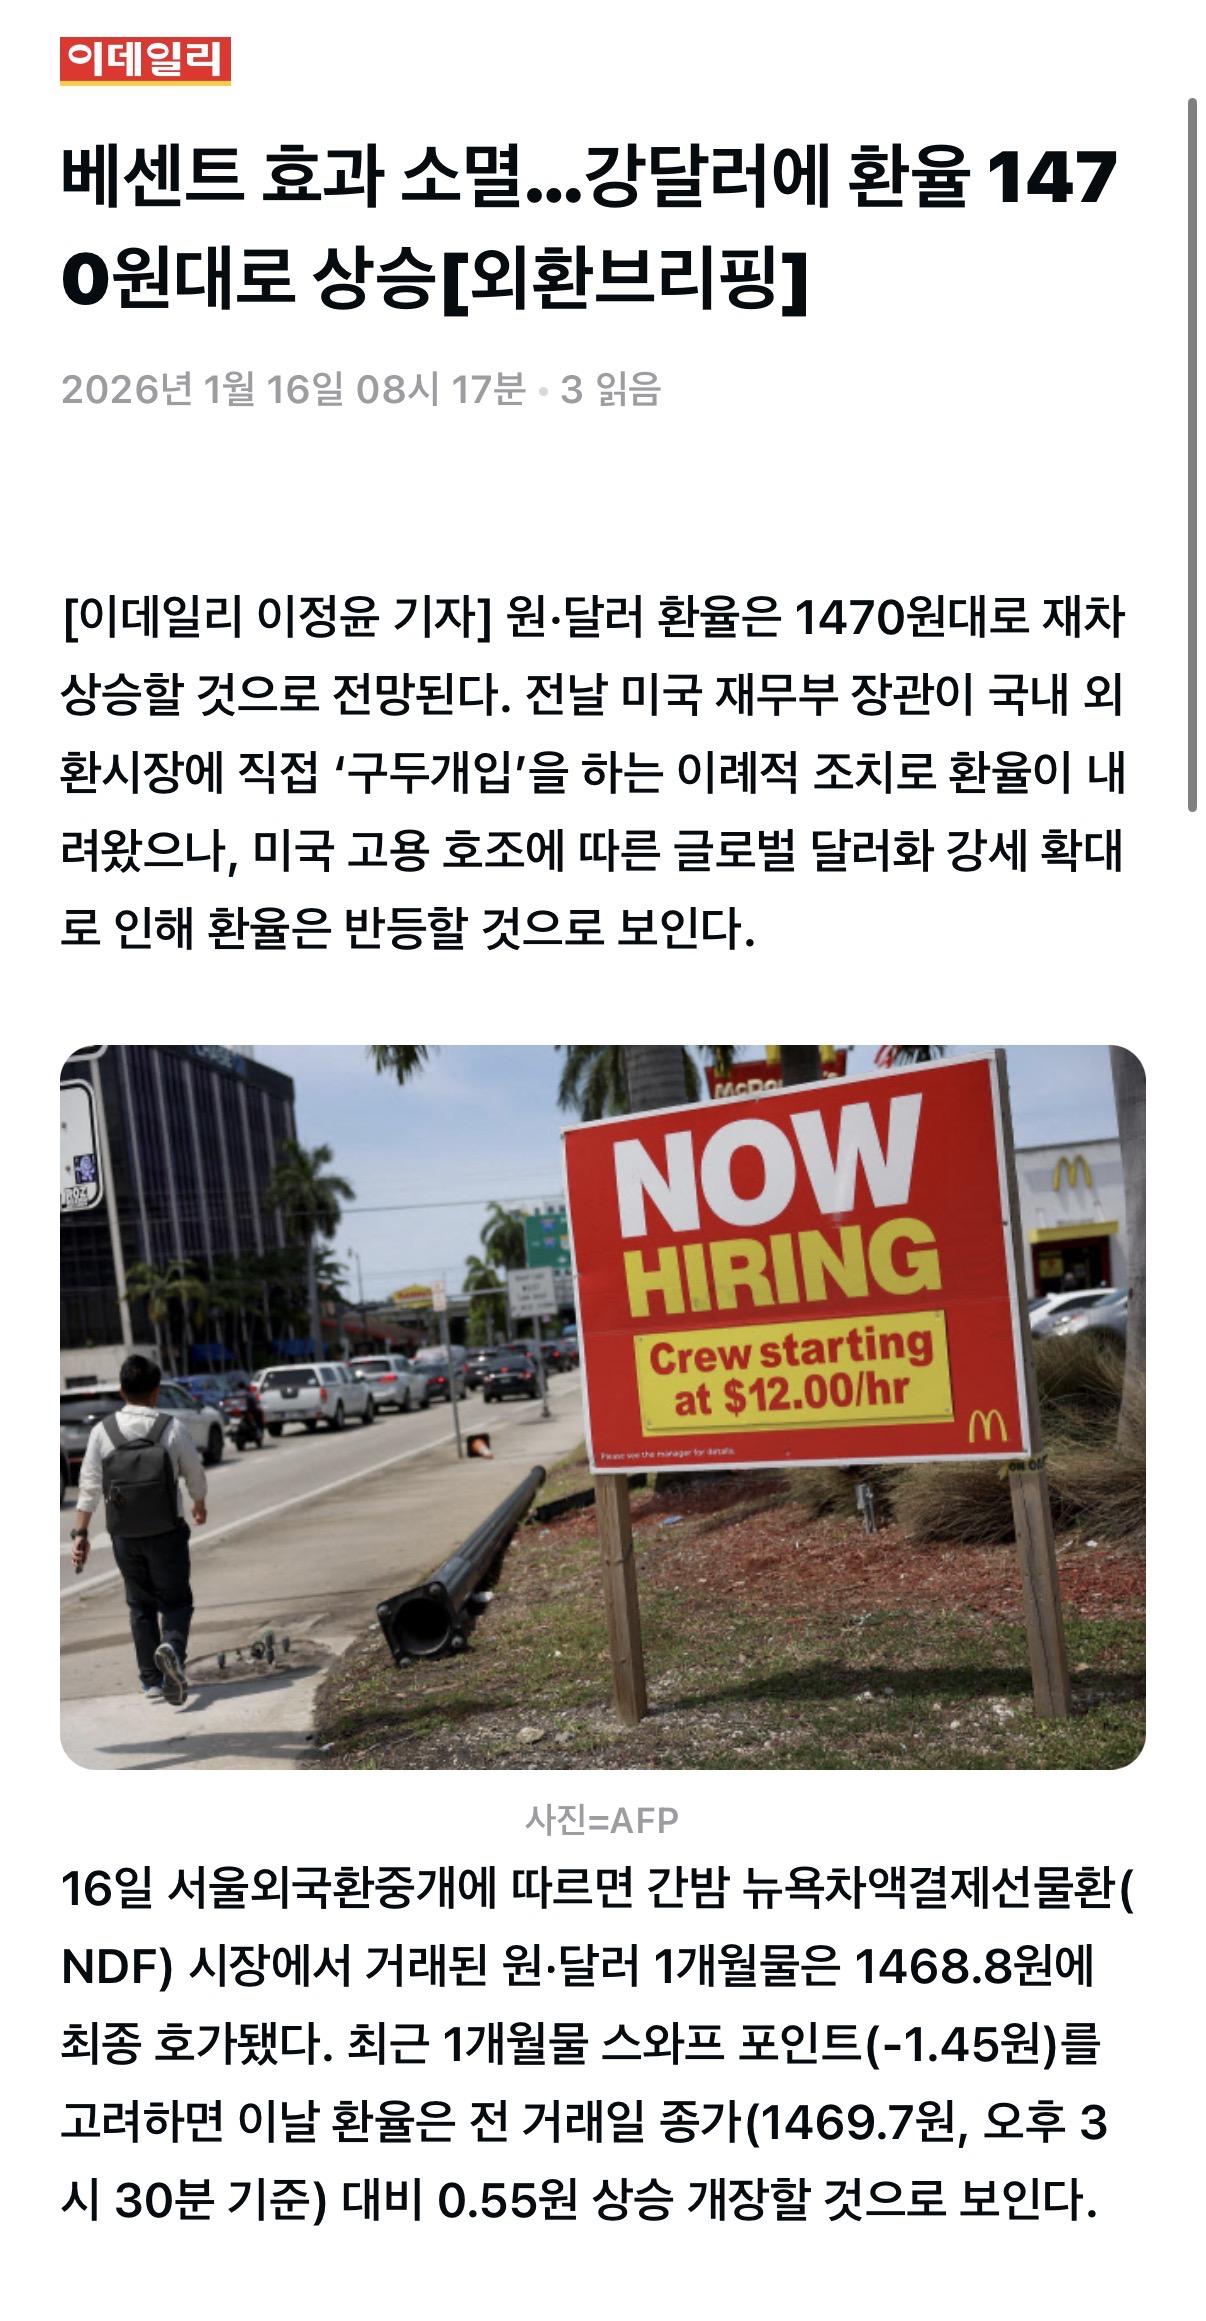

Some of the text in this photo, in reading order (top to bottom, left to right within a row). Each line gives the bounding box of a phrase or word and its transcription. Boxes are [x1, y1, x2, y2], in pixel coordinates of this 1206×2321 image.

[68, 41, 221, 77] 이데일리
[63, 143, 244, 208] 베센트
[263, 143, 385, 208] 효과
[849, 143, 971, 208] 환율
[990, 151, 1116, 202] 147
[63, 245, 806, 317] 0원대로 상승[외환브리핑]
[63, 371, 661, 406] 2026년 1월 16일 08시 17분 3 읽음
[66, 595, 240, 643] [이데일리
[258, 595, 379, 638] 이정윤
[394, 595, 490, 643] 기자]
[658, 595, 781, 638] 환율은
[797, 595, 1029, 638] 1470원대로
[1042, 595, 1125, 638] 재차
[60, 673, 1121, 716] 상승할 것으로 전망된다. 전날 미국 재무부 장관이 국내 외
[60, 751, 222, 794] 환시장에
[239, 751, 316, 794] 직접
[582, 751, 663, 794] 하는
[678, 751, 796, 794] 이례적
[814, 751, 936, 794] 조치로
[949, 751, 1069, 794] 환율이
[1089, 751, 1124, 794] 내
[63, 829, 1121, 877] 려왔으나, 미국 고용 호조에 따른 글로벌 달러화 강세 확대
[61, 907, 754, 950] 로 인해 환율은 반등할 것으로 보인다.
[613, 1093, 922, 1239] NOW
[623, 1217, 942, 1317] HIRING
[650, 1326, 933, 1375] Crew starting
[675, 1371, 911, 1417] at $12.00/hr
[641, 1450, 655, 1458] the
[526, 1804, 678, 1836] 사진=AFP
[63, 1866, 1133, 1914] 16일 서울외국환중개에 따르면 간밤 뉴욕차액결제선물환(
[64, 1947, 172, 1992] NDF)
[189, 1944, 349, 1987] 시장에서
[366, 1944, 486, 1987] 거래된
[656, 1944, 840, 1987] 1개월물은
[857, 1944, 1092, 1987] 1468.8원에
[61, 2022, 1100, 2070] 최종 호가됐다. 최근 1개월물 스와프 포인트(-1.45원)를
[61, 2100, 1107, 2148] 고려하면 이날 환율은 전 거래일 종가(1469.7원, 오후 3
[61, 2178, 1096, 2226] 시 30분 기준) 대비 0.55원 상승 개장할 것으로 보인다.
